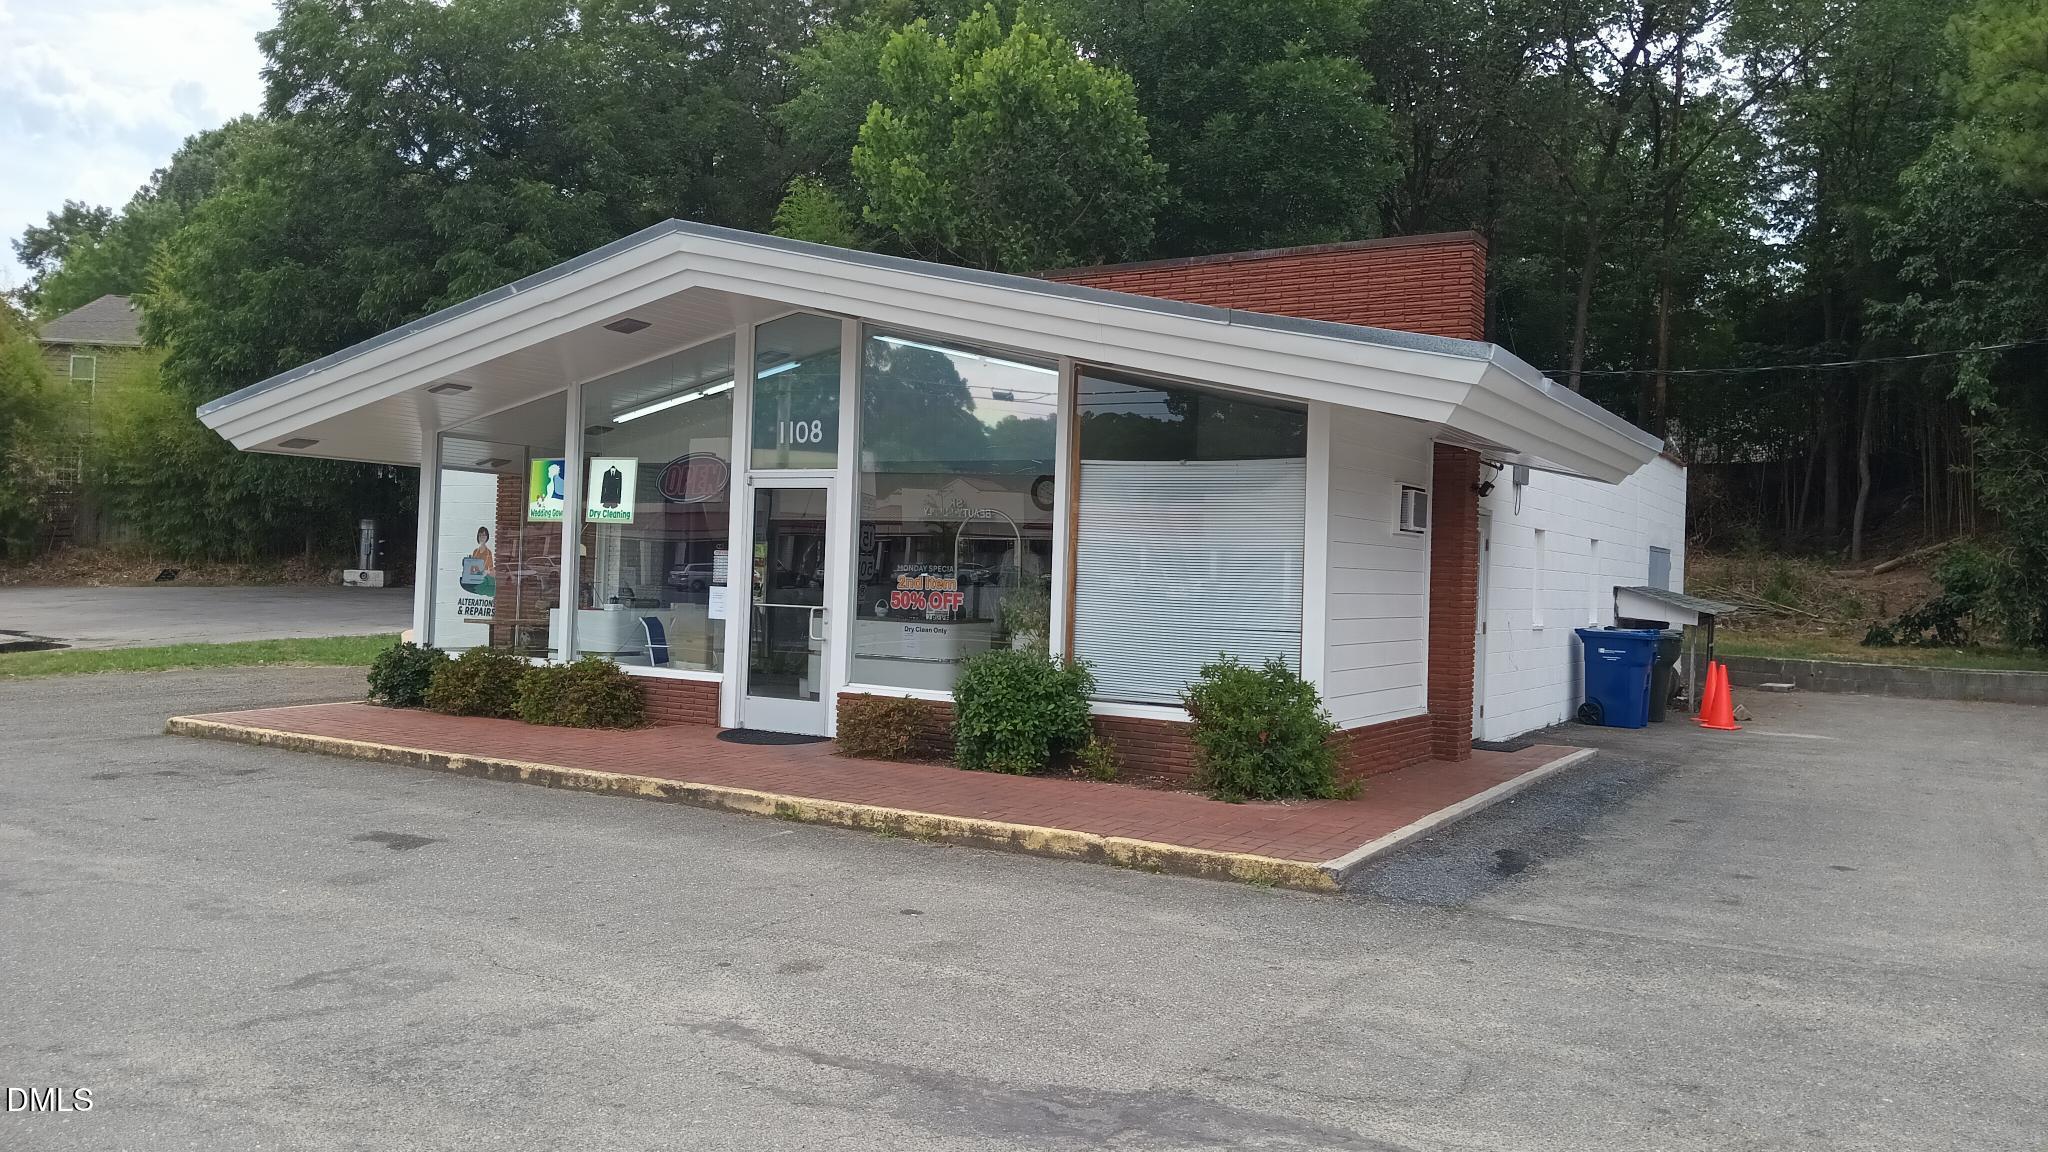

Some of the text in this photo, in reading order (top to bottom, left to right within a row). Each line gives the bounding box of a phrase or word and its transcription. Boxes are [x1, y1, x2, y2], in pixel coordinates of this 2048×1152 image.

[780, 420, 822, 444] 1108
[665, 463, 722, 496] OPEN
[530, 508, 551, 518] Wedding
[589, 509, 631, 520] Dry Cleaning
[897, 564, 957, 573] MONDAY SPECIA
[897, 575, 958, 592] 2nd Item
[890, 591, 964, 611] 50% OFF
[457, 606, 496, 617] & REPAIRS
[904, 625, 915, 634] Dry
[933, 627, 948, 635] Only
